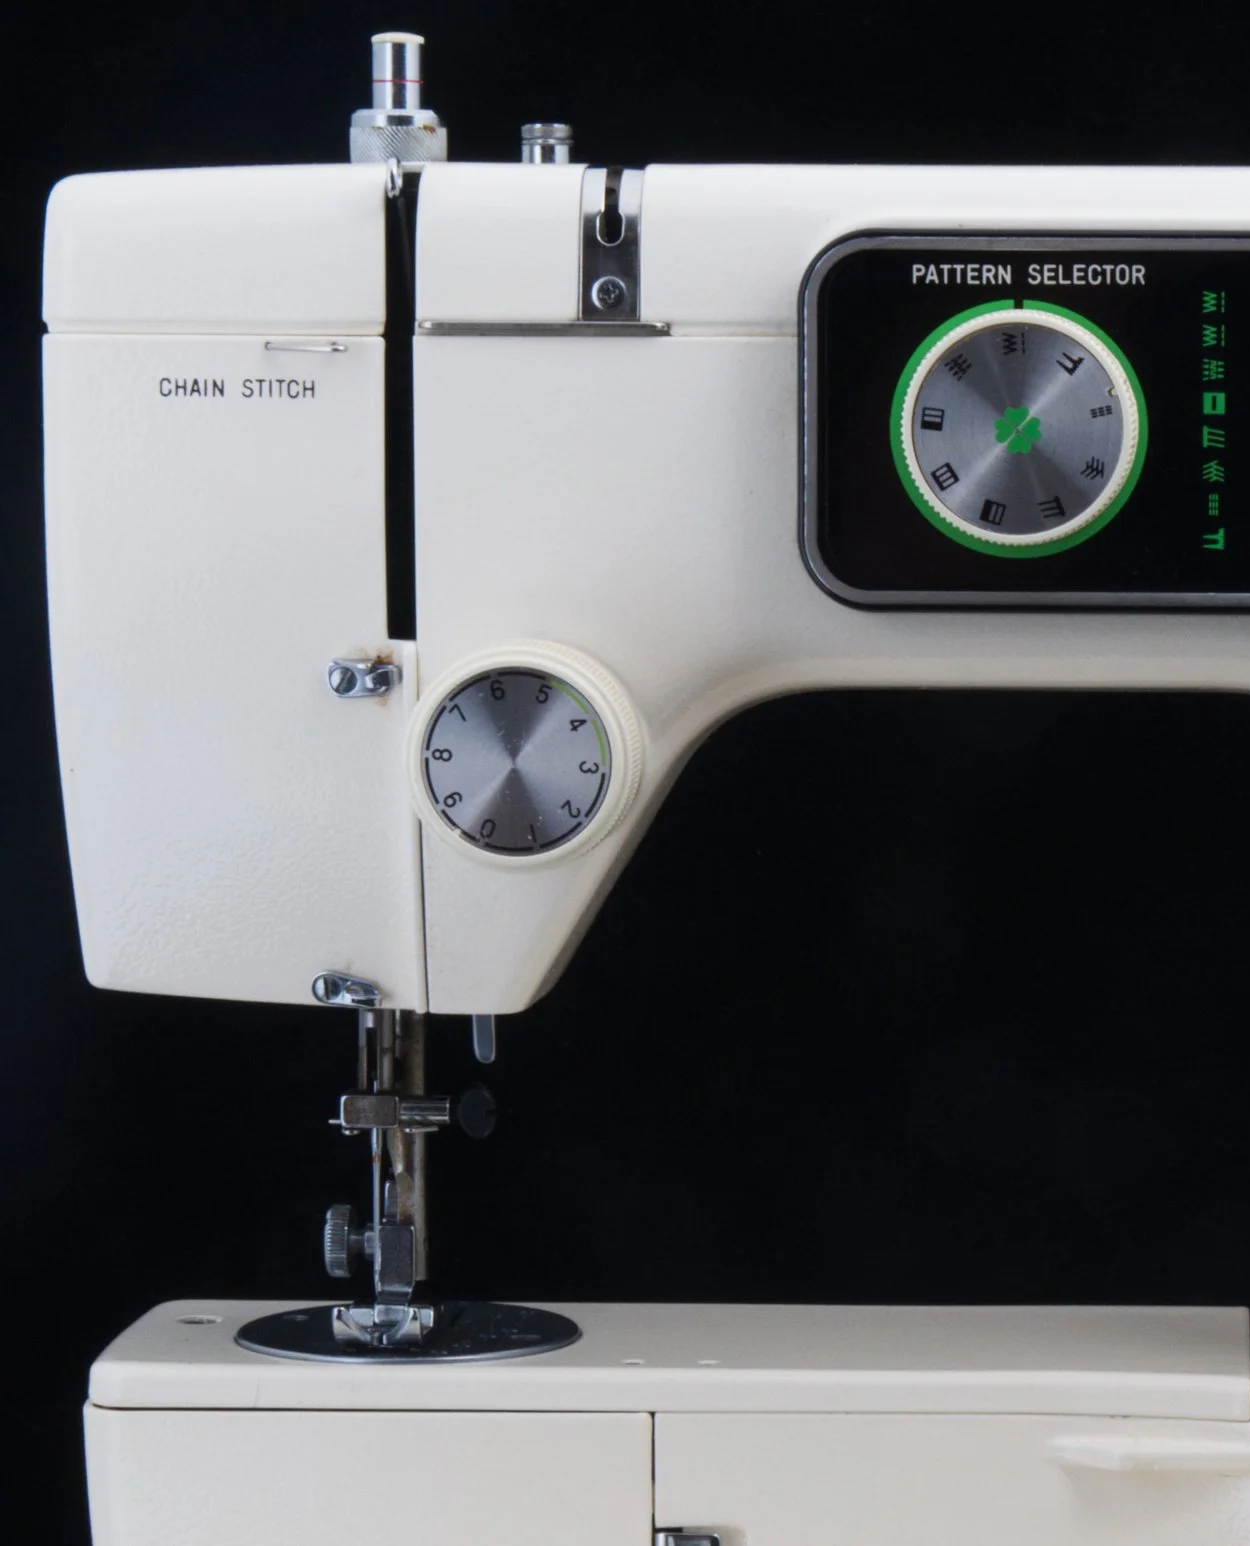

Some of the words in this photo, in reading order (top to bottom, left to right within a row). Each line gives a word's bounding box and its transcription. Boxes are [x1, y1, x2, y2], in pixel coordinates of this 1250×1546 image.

[912, 263, 1012, 285] PATTERN
[1027, 263, 1146, 286] SELECTOR
[160, 378, 224, 397] CHAIN
[242, 379, 315, 399] STITCH
[489, 679, 506, 701] 6
[535, 683, 552, 704] 5
[449, 703, 467, 722] 7
[569, 717, 587, 732] 4
[431, 748, 453, 763] 8
[579, 760, 599, 775] 3
[560, 800, 581, 819] 2
[480, 818, 496, 839] 0
